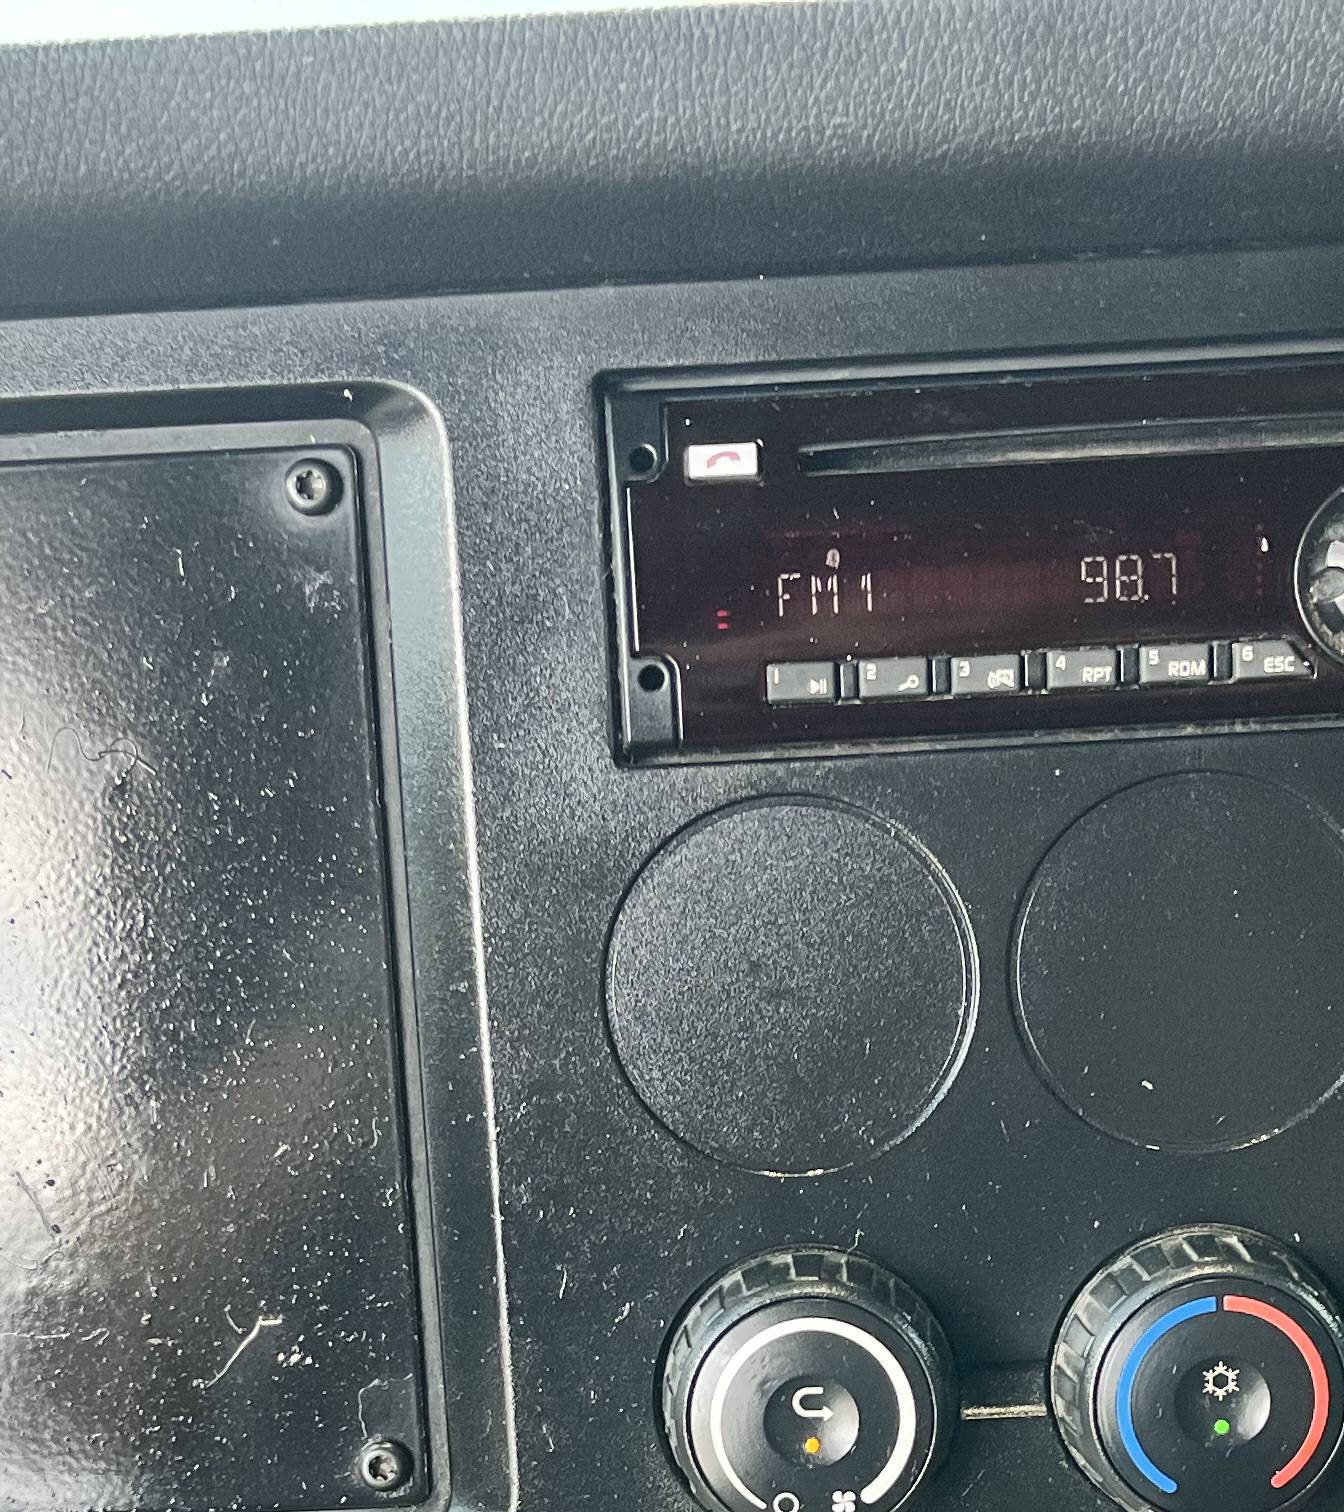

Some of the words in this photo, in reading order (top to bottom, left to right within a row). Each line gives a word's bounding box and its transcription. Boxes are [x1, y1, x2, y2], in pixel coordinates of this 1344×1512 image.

[1148, 650, 1159, 666] 5
[1242, 645, 1254, 662] 6
[959, 661, 971, 678] 3
[1055, 654, 1067, 671] 4
[1168, 659, 1207, 677] RDM
[1263, 655, 1296, 673] ESC
[865, 662, 878, 681] 2
[1081, 666, 1113, 683] RPT
